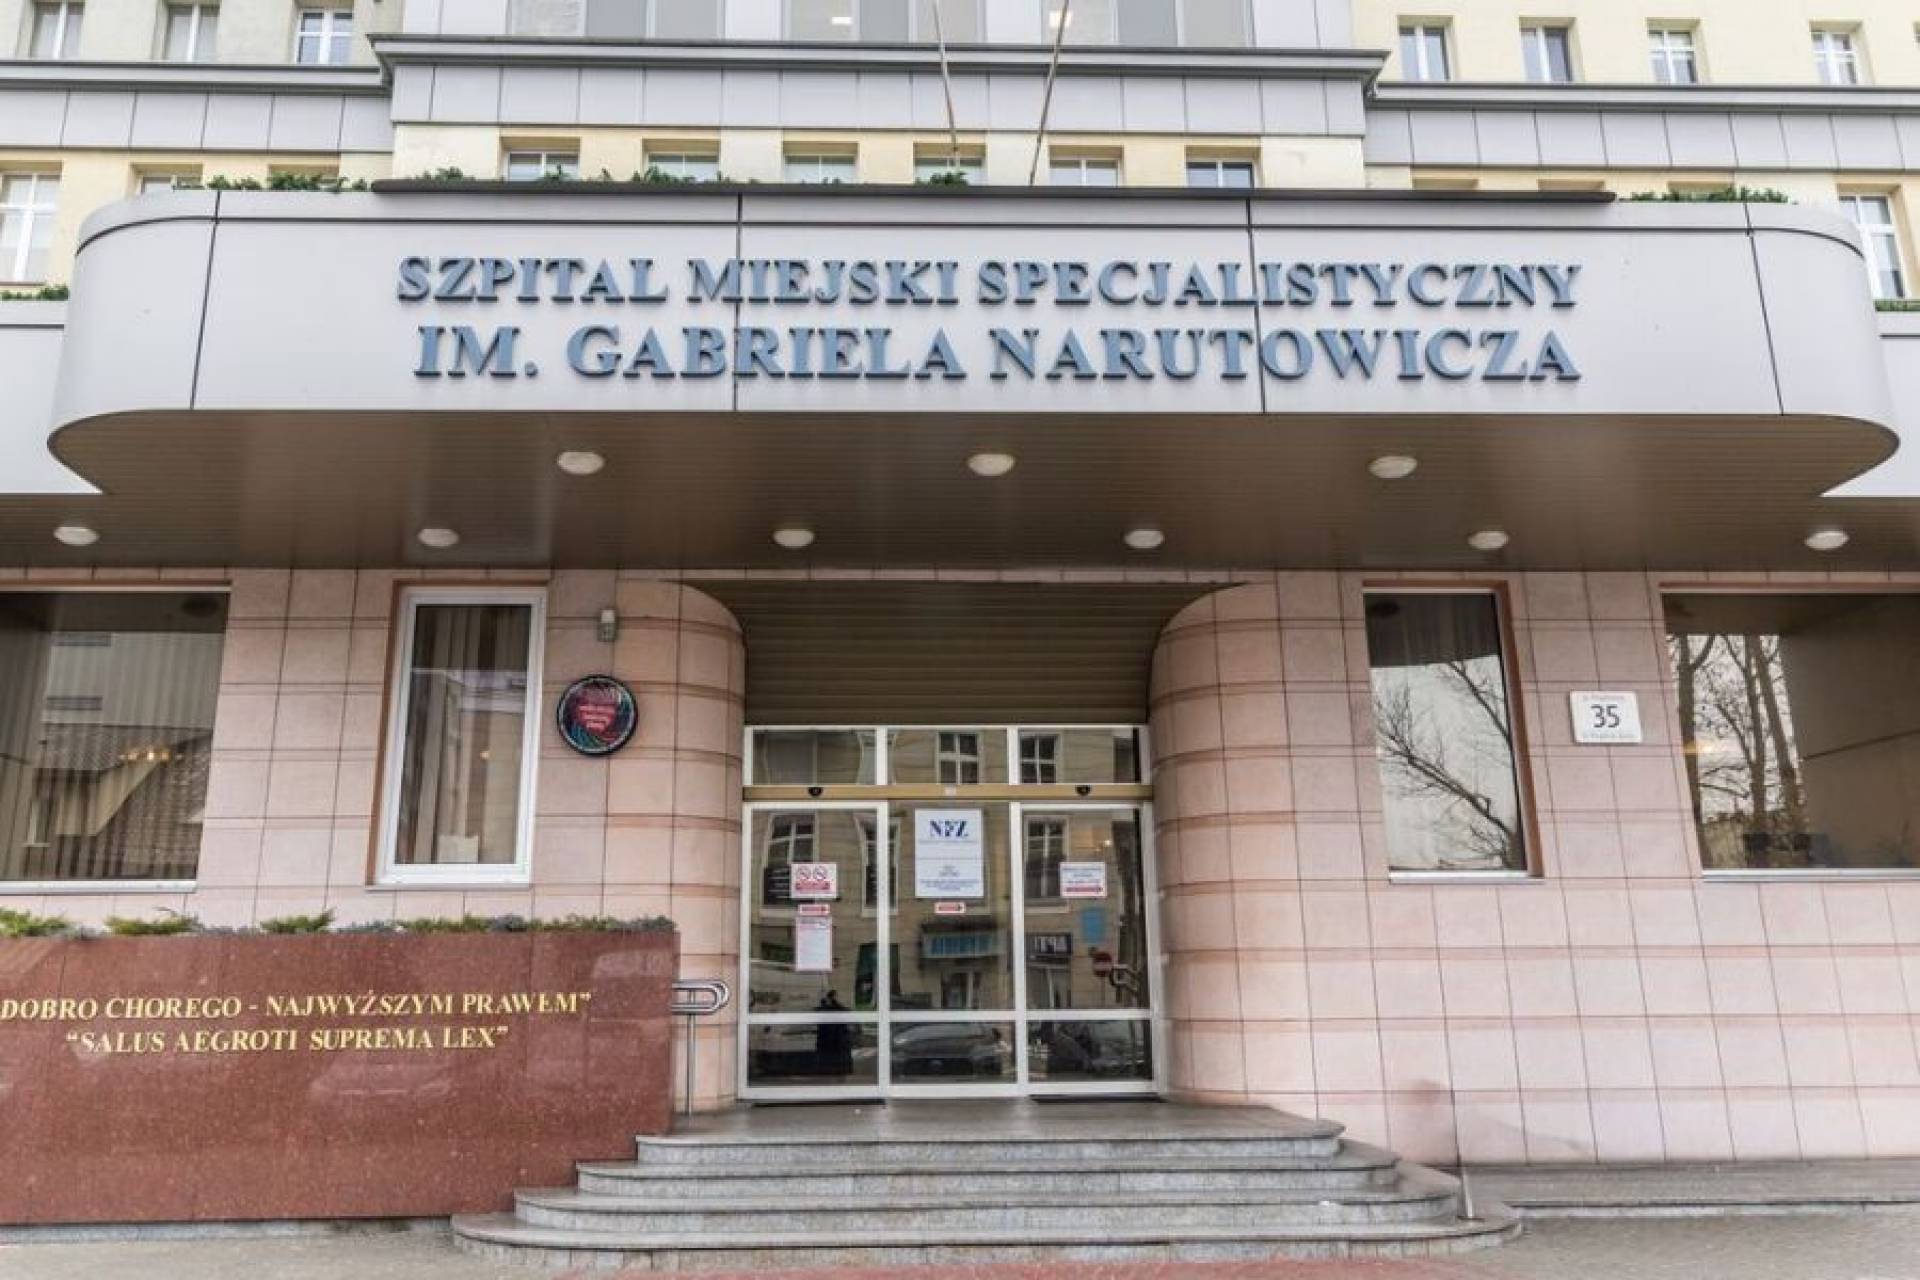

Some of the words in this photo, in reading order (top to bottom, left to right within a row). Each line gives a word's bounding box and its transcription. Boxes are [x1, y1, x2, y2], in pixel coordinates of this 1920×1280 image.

[397, 256, 669, 302] SZPITAL
[687, 258, 959, 304] MIEJSKI
[978, 259, 1582, 308] SPECJALISTYCZNY
[413, 324, 538, 379] IM.
[565, 325, 967, 379] GABRIELA
[988, 327, 1582, 382] NARUTOWICZA
[1590, 703, 1621, 729] 35
[929, 819, 969, 838] NFZ
[0, 998, 99, 1020] DOBRO
[105, 996, 242, 1019] CHOREGO
[266, 988, 453, 1017] NAJWYŻSZYM
[175, 1029, 298, 1052] AEGROTI
[309, 1027, 434, 1051] SUPREMA
